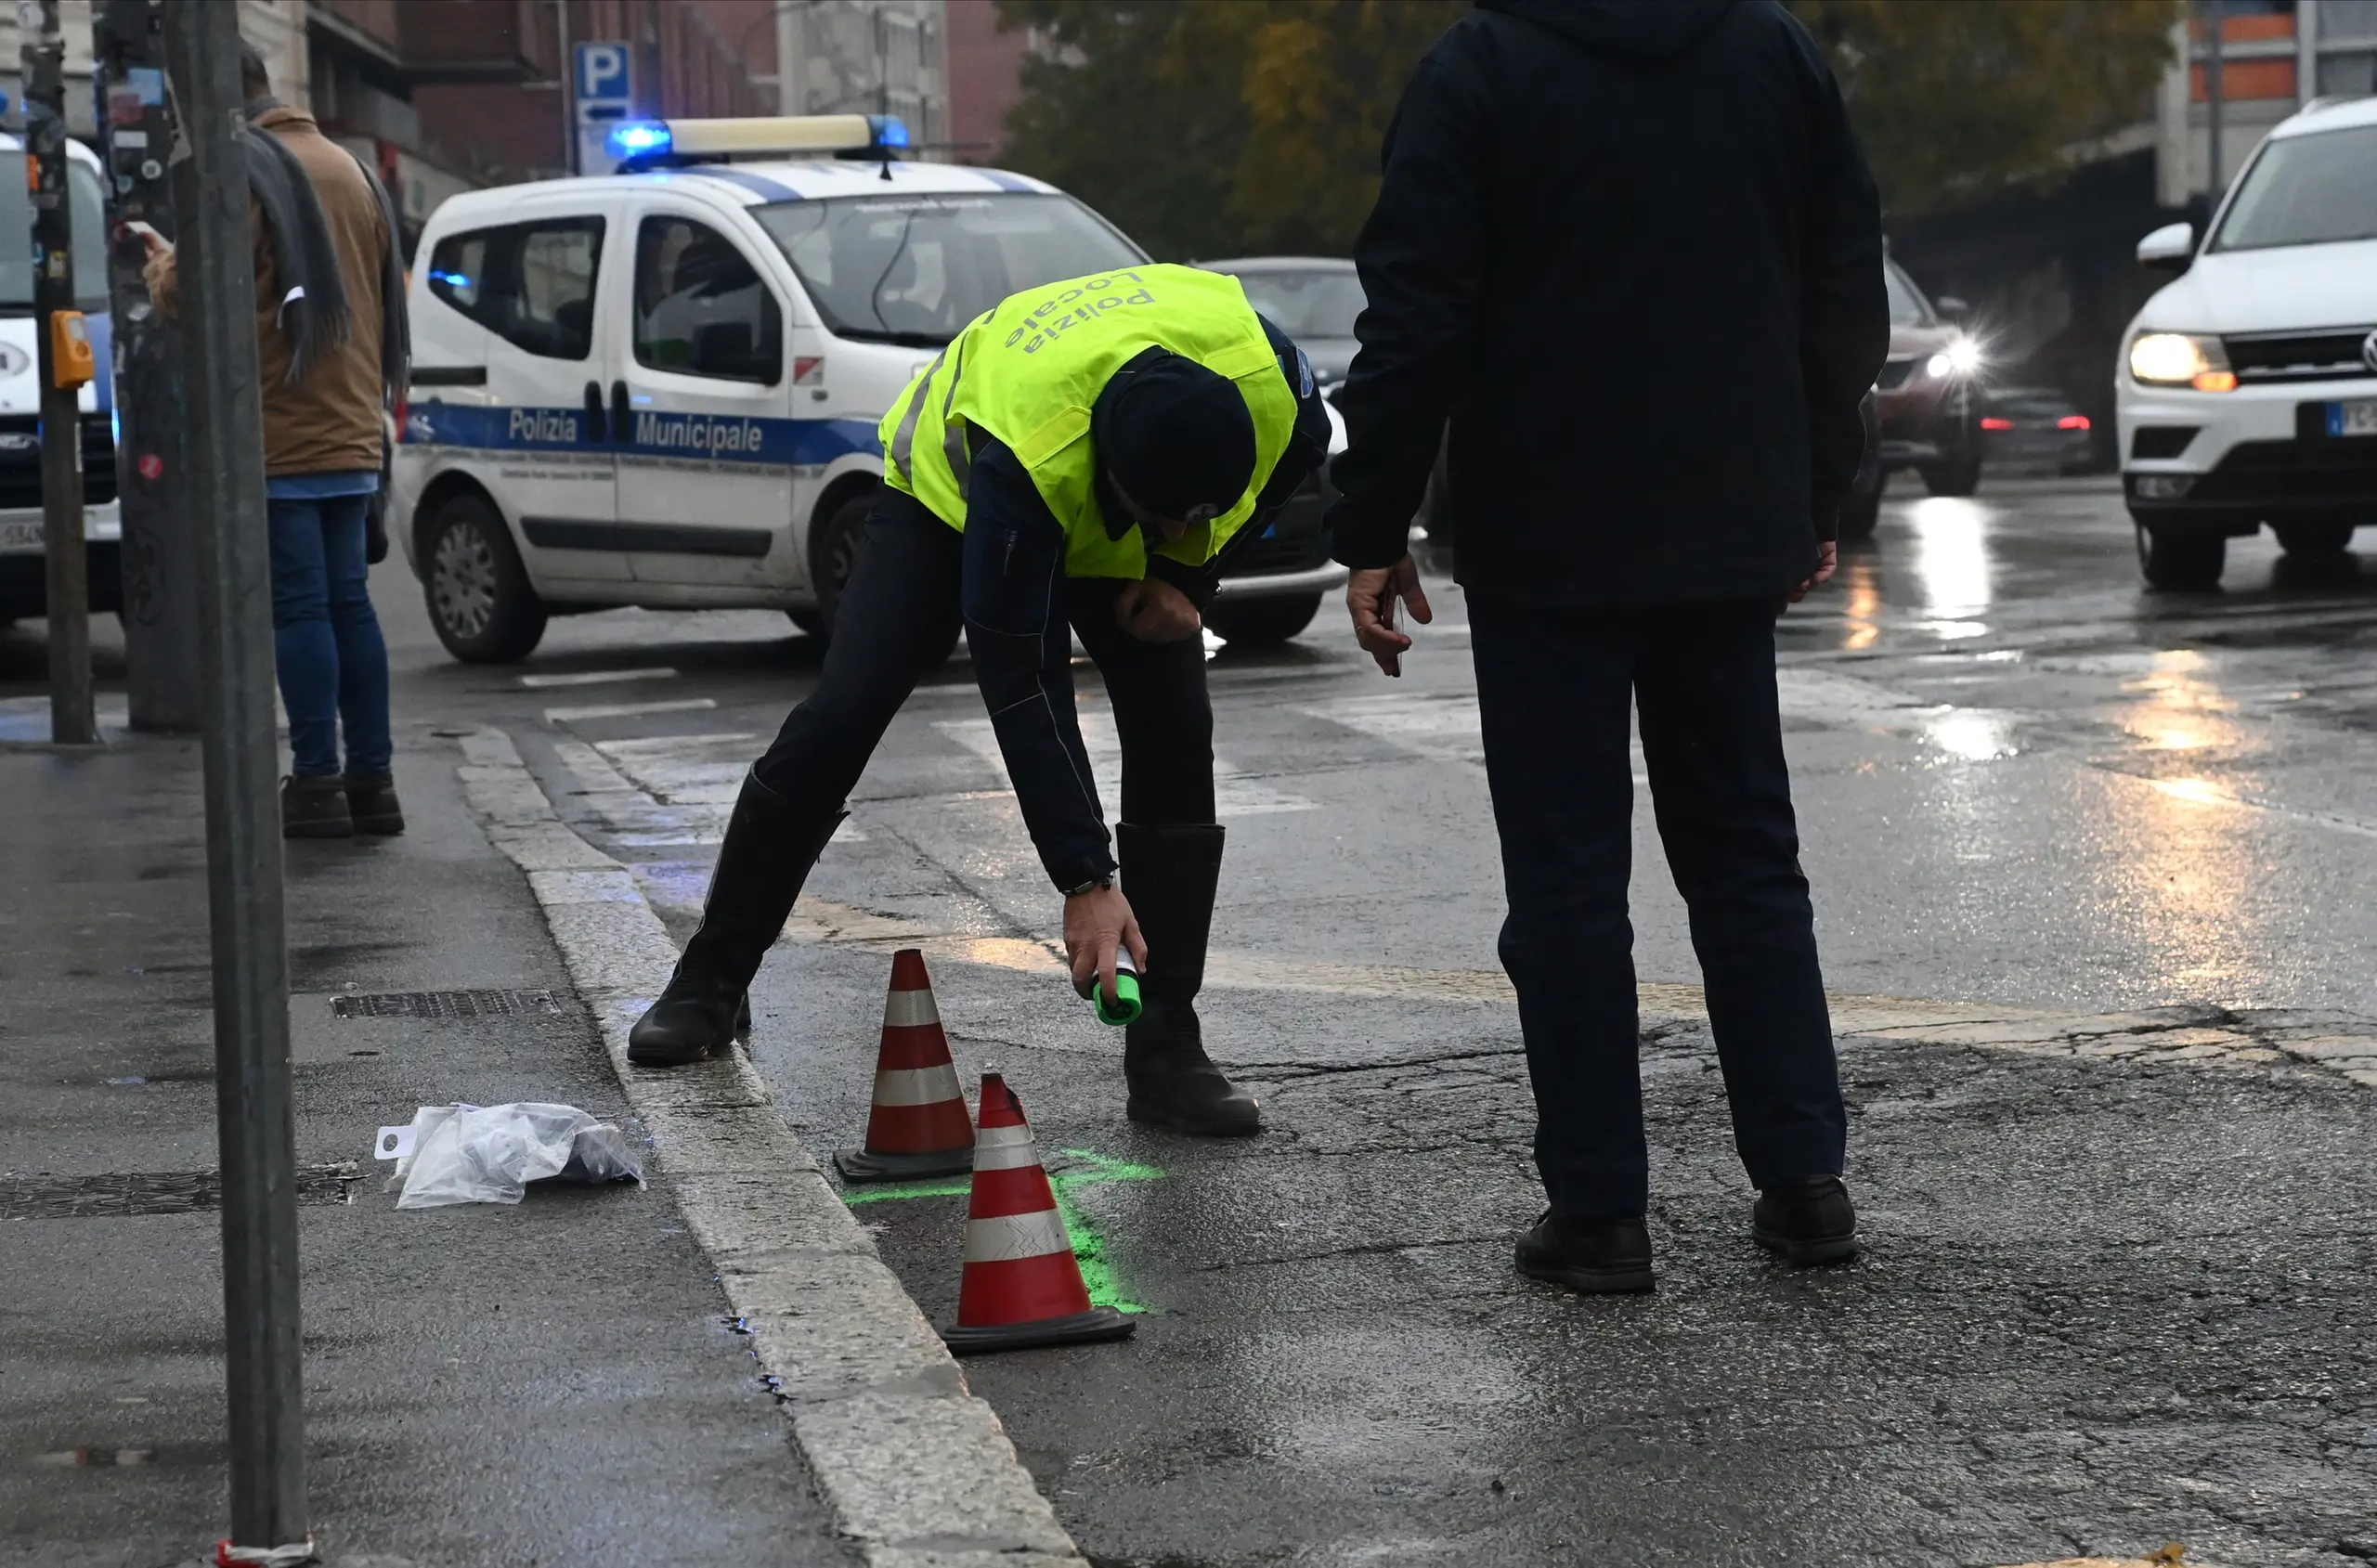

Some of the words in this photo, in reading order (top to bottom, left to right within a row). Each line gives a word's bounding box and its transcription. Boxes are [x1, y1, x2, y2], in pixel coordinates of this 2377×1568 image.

[584, 46, 621, 96] P
[1004, 271, 1144, 349] Locale
[1023, 288, 1156, 355] Polizia
[509, 408, 578, 444] Polizia
[636, 411, 763, 459] Municipale
